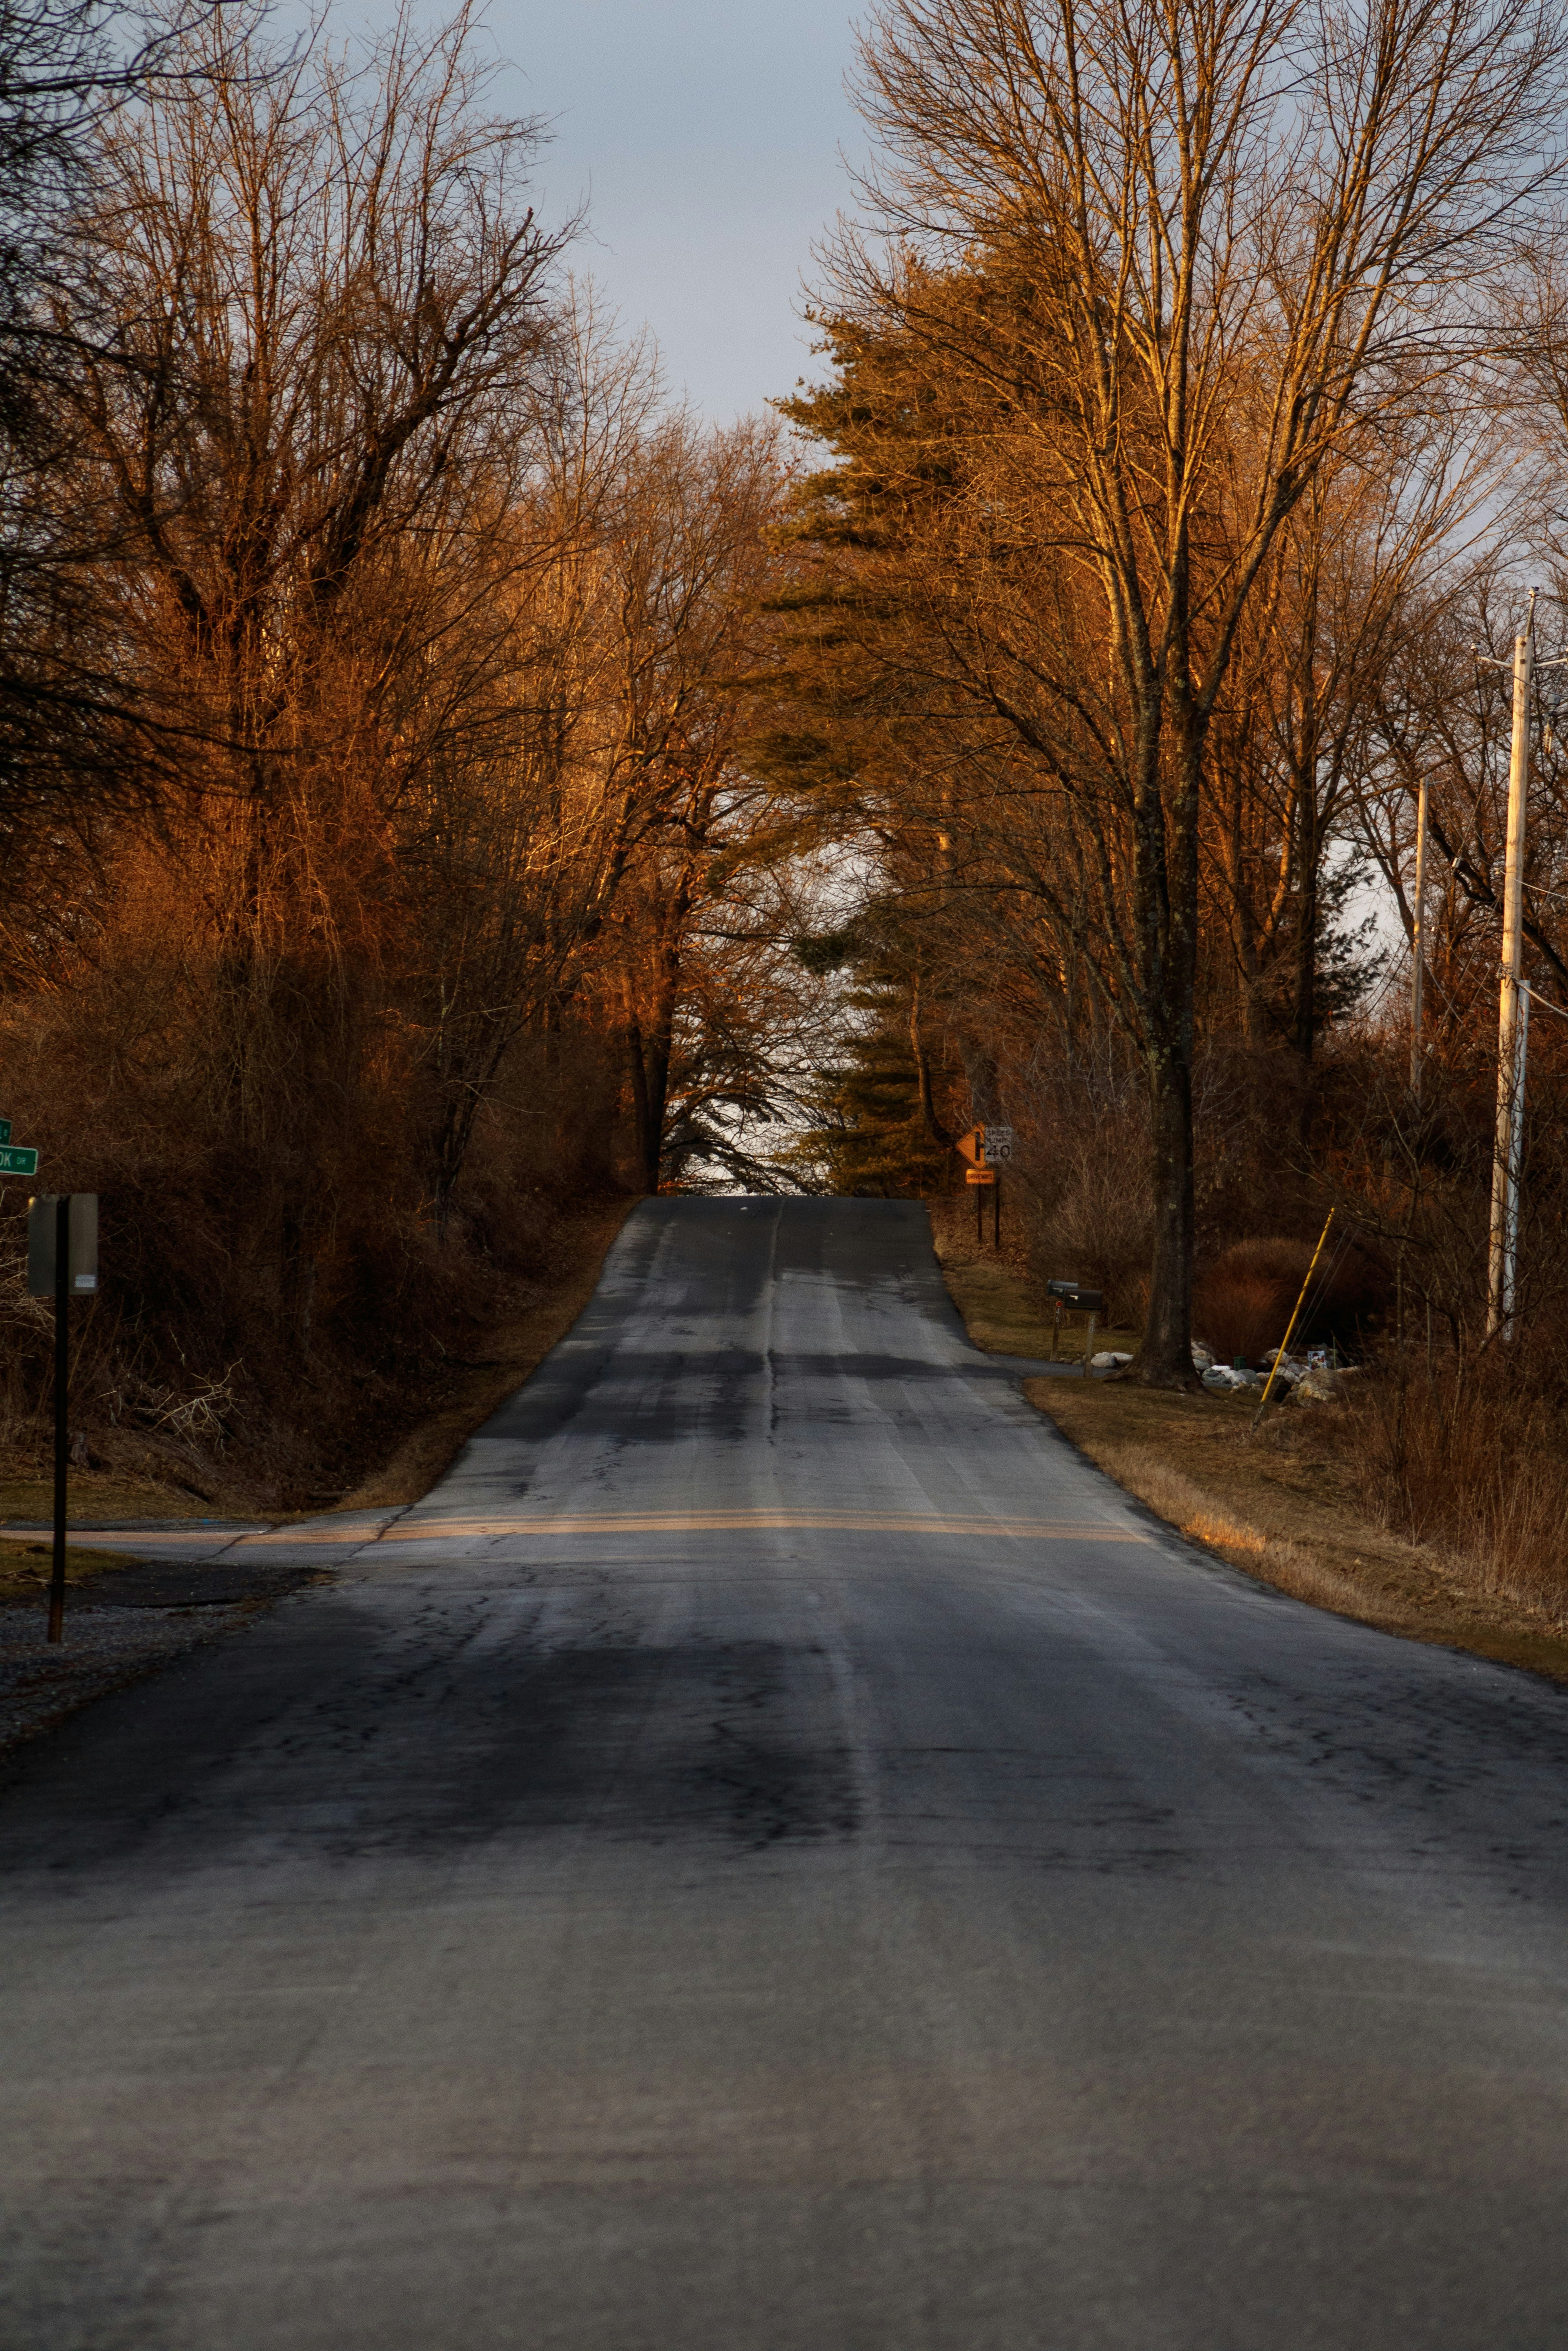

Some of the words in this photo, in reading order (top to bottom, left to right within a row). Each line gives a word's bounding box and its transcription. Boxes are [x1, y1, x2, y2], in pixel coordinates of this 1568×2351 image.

[986, 1145, 1010, 1158] 40
[16, 1157, 26, 1165] DR
[1056, 1308, 1060, 1322] 46
